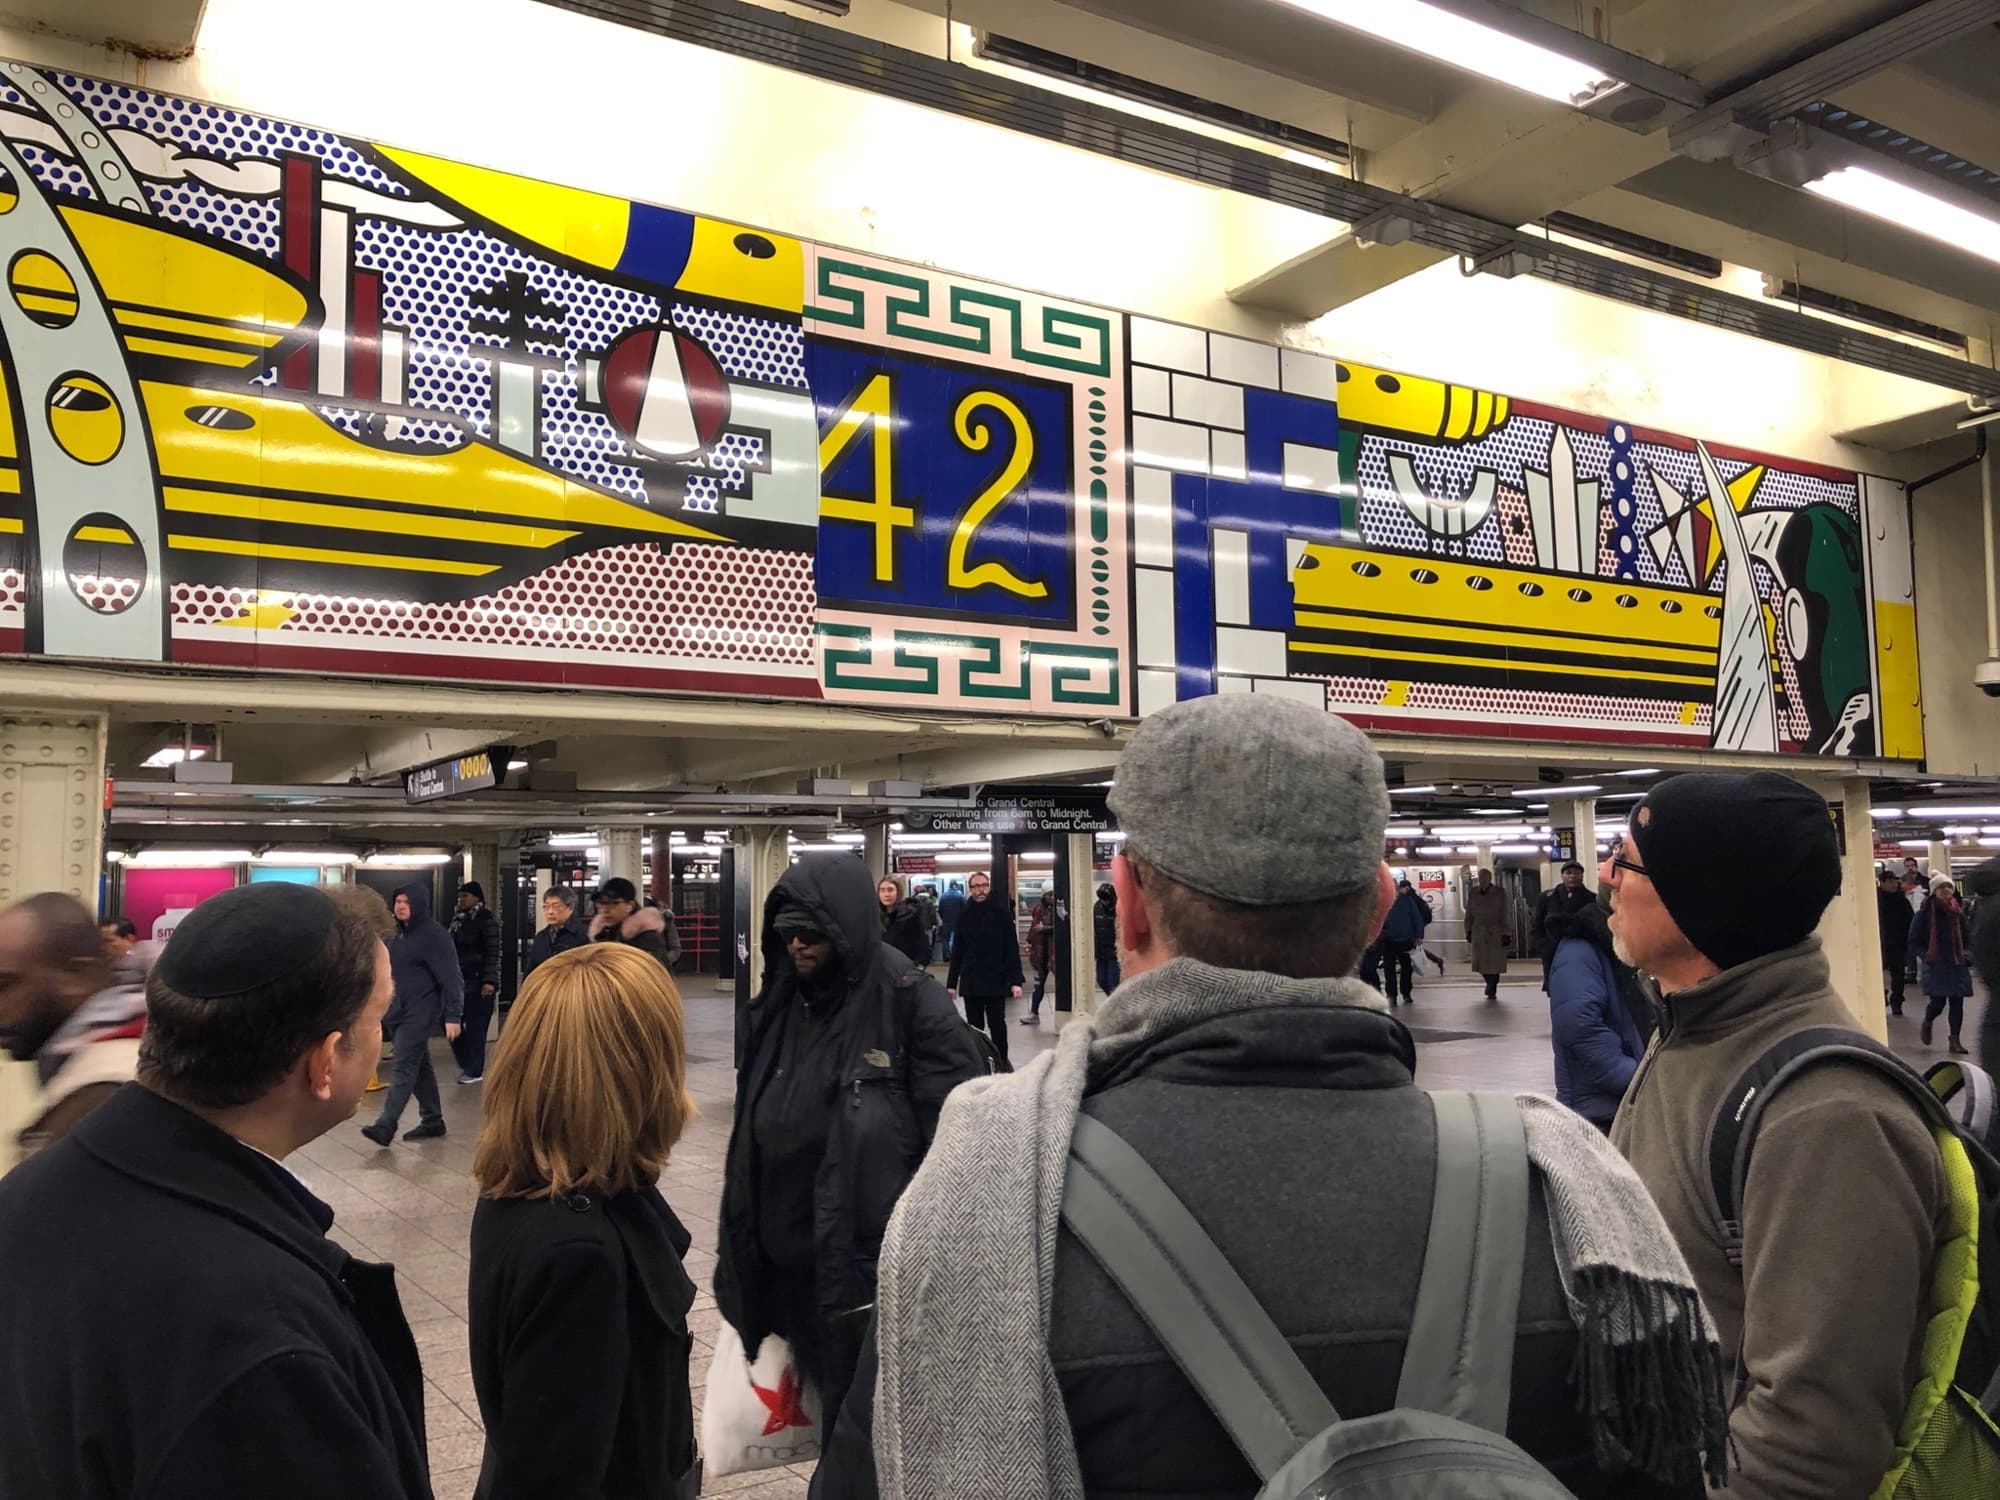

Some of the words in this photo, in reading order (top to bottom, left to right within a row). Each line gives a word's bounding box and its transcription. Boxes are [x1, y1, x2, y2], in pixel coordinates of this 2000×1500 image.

[819, 373, 1048, 598] 42
[987, 797, 1017, 808] Grand
[1020, 797, 1056, 808] Central
[984, 808, 1008, 818] from
[1010, 808, 1033, 818] 6am
[1036, 808, 1047, 818] to
[1049, 808, 1092, 820] Midnight.
[932, 819, 962, 830] Other
[966, 819, 994, 830] times
[997, 821, 1016, 830] use
[1028, 820, 1038, 830] to
[1041, 819, 1070, 830] Grand
[1073, 819, 1108, 830] Central
[1421, 871, 1443, 880] 1925
